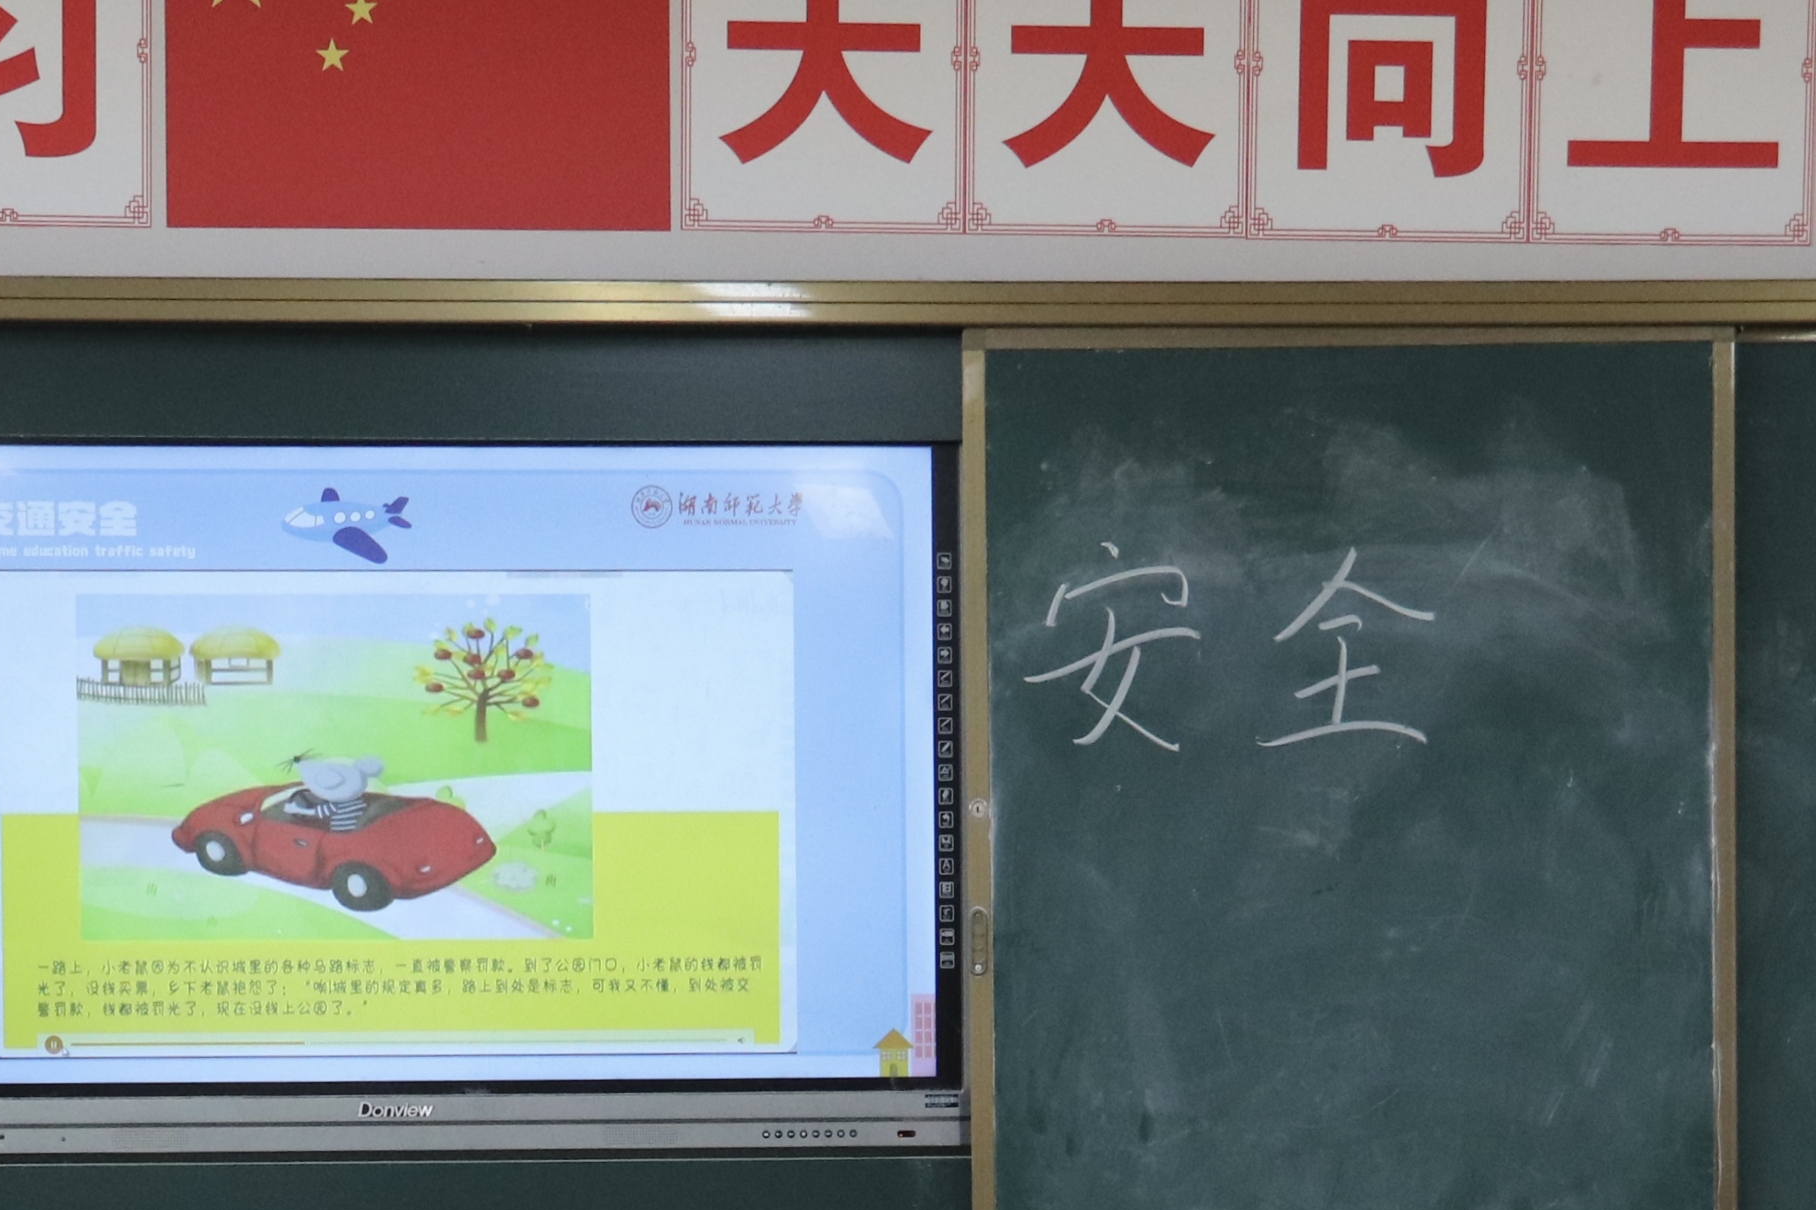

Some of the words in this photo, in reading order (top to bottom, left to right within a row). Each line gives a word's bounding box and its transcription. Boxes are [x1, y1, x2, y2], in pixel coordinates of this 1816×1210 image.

[719, 0, 1779, 177] 天天向上
[23, 544, 89, 558] education
[95, 544, 144, 558] traffic
[149, 544, 197, 560] safety
[1023, 541, 1436, 752] 安全
[358, 1101, 433, 1118] Donview
